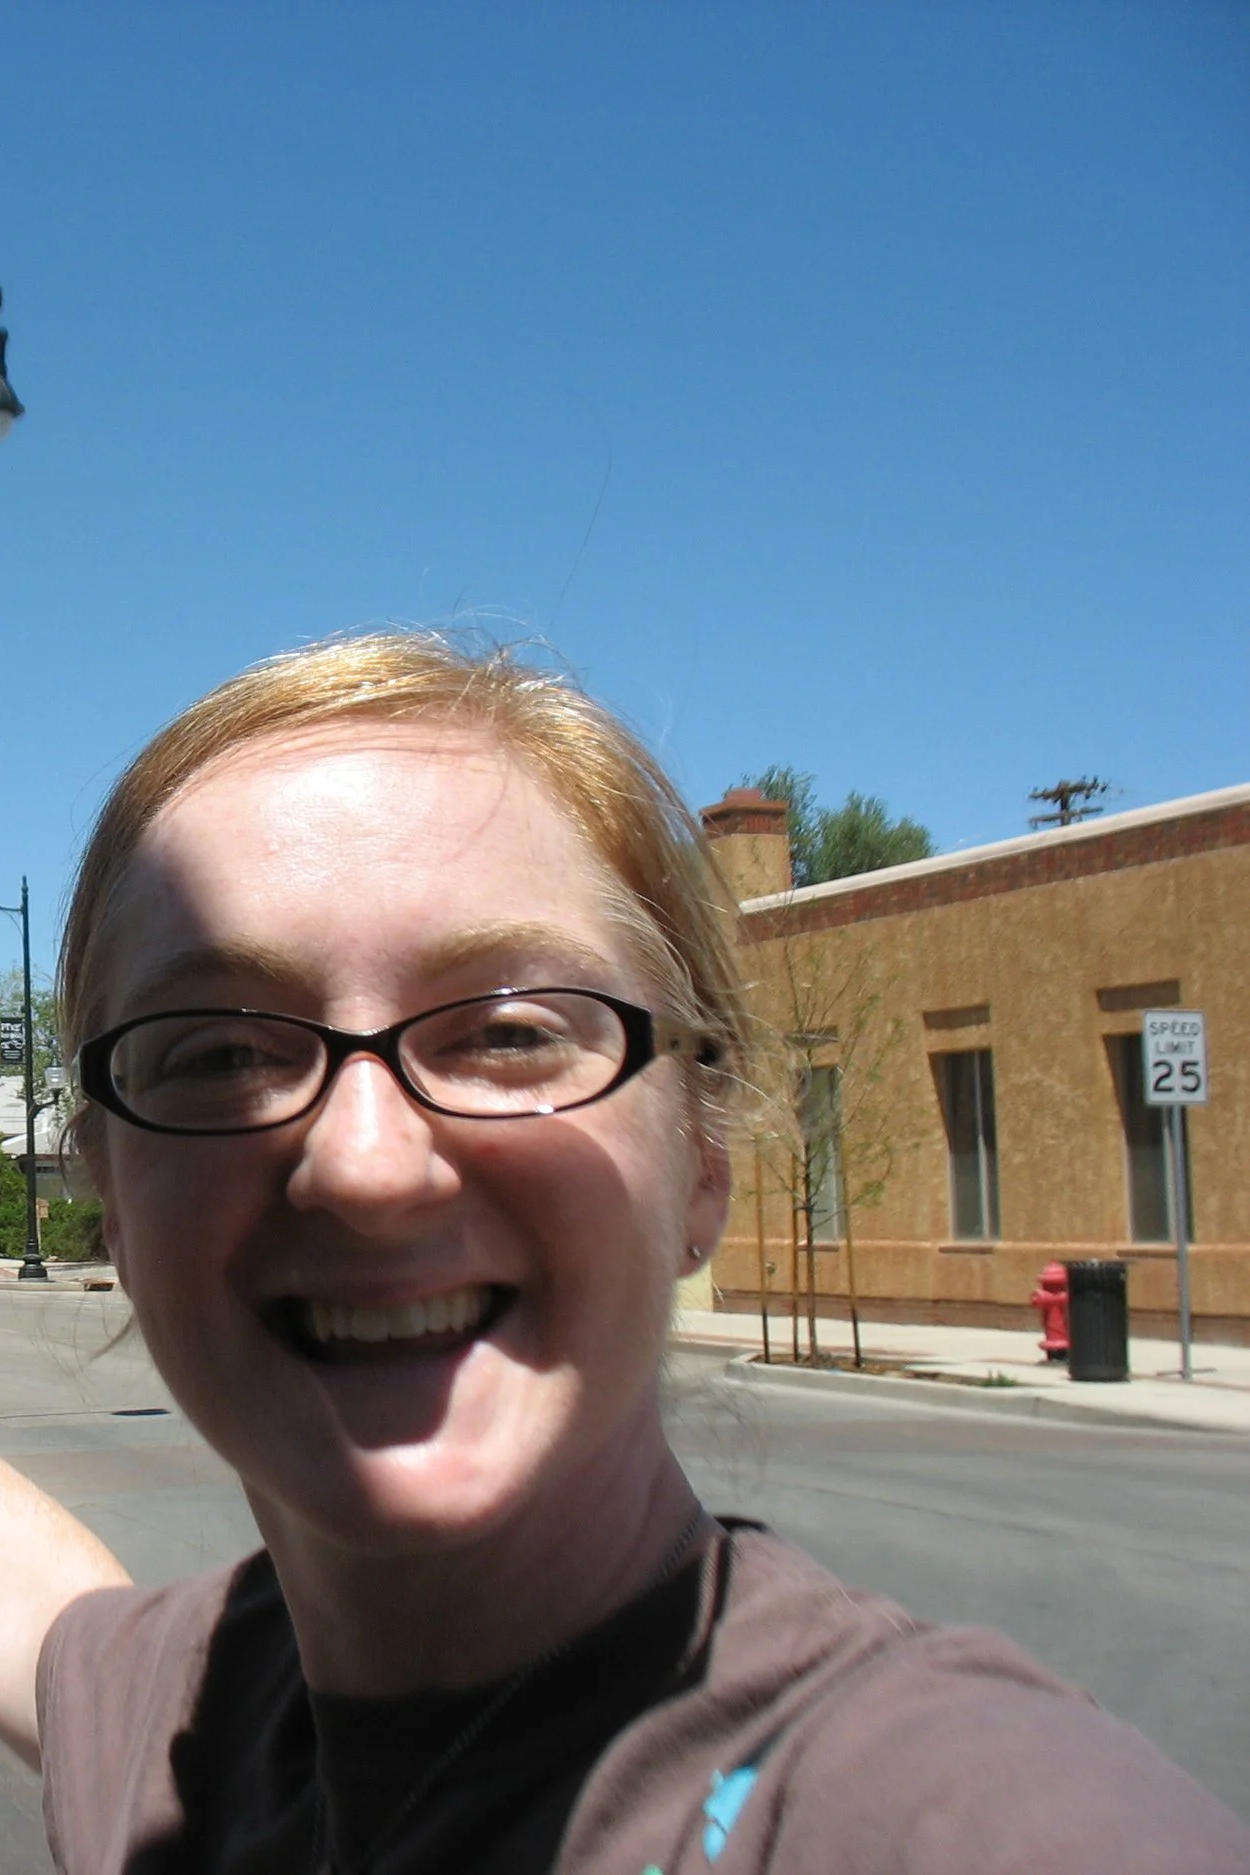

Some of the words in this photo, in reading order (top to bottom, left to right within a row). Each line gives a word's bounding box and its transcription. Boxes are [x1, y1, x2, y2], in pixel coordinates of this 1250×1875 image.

[1150, 1021, 1201, 1036] SPEED
[1155, 1041, 1196, 1055] LIMIT
[1153, 1060, 1202, 1093] 25
